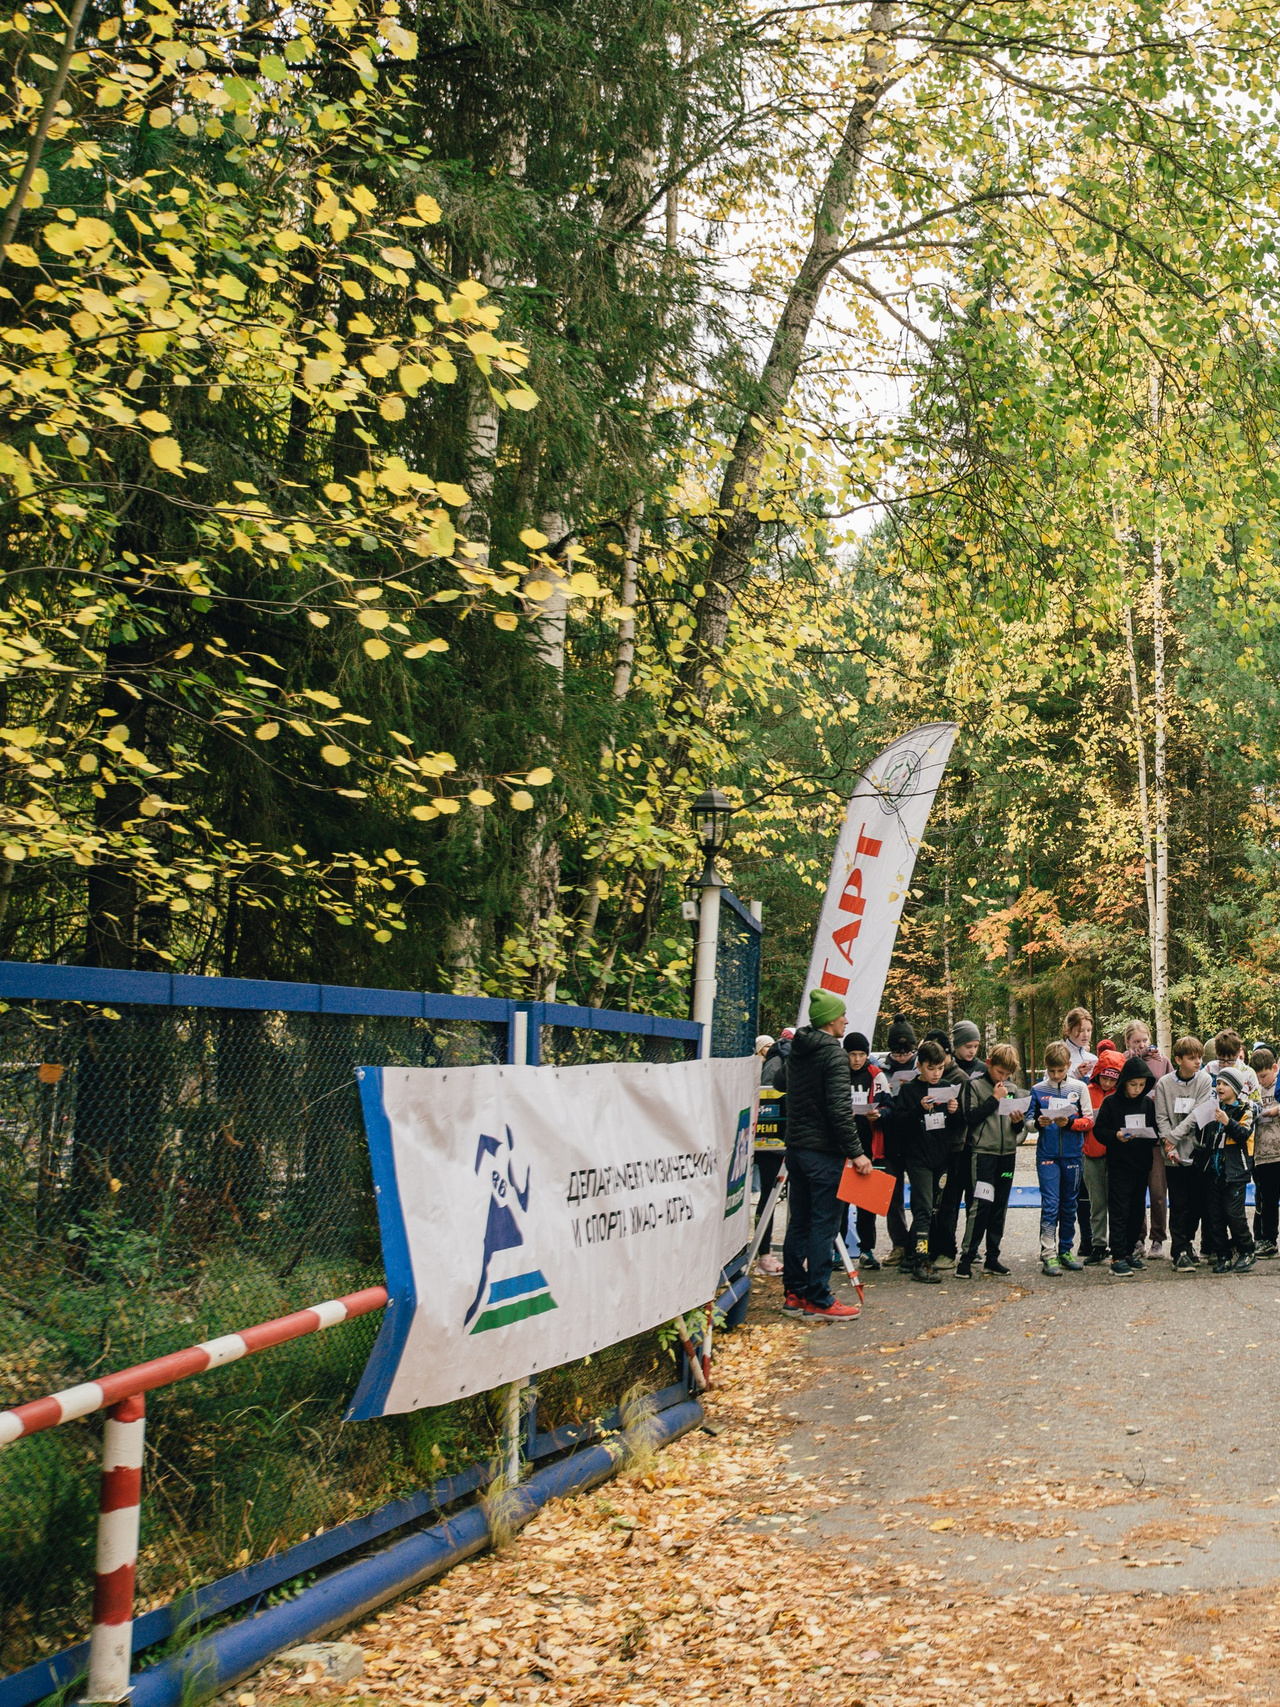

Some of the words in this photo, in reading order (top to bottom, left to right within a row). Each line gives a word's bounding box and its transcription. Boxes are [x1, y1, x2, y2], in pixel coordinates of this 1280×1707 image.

[820, 822, 883, 997] ТАРТ
[756, 1123, 778, 1134] РЕМЯ
[571, 1217, 583, 1248] И
